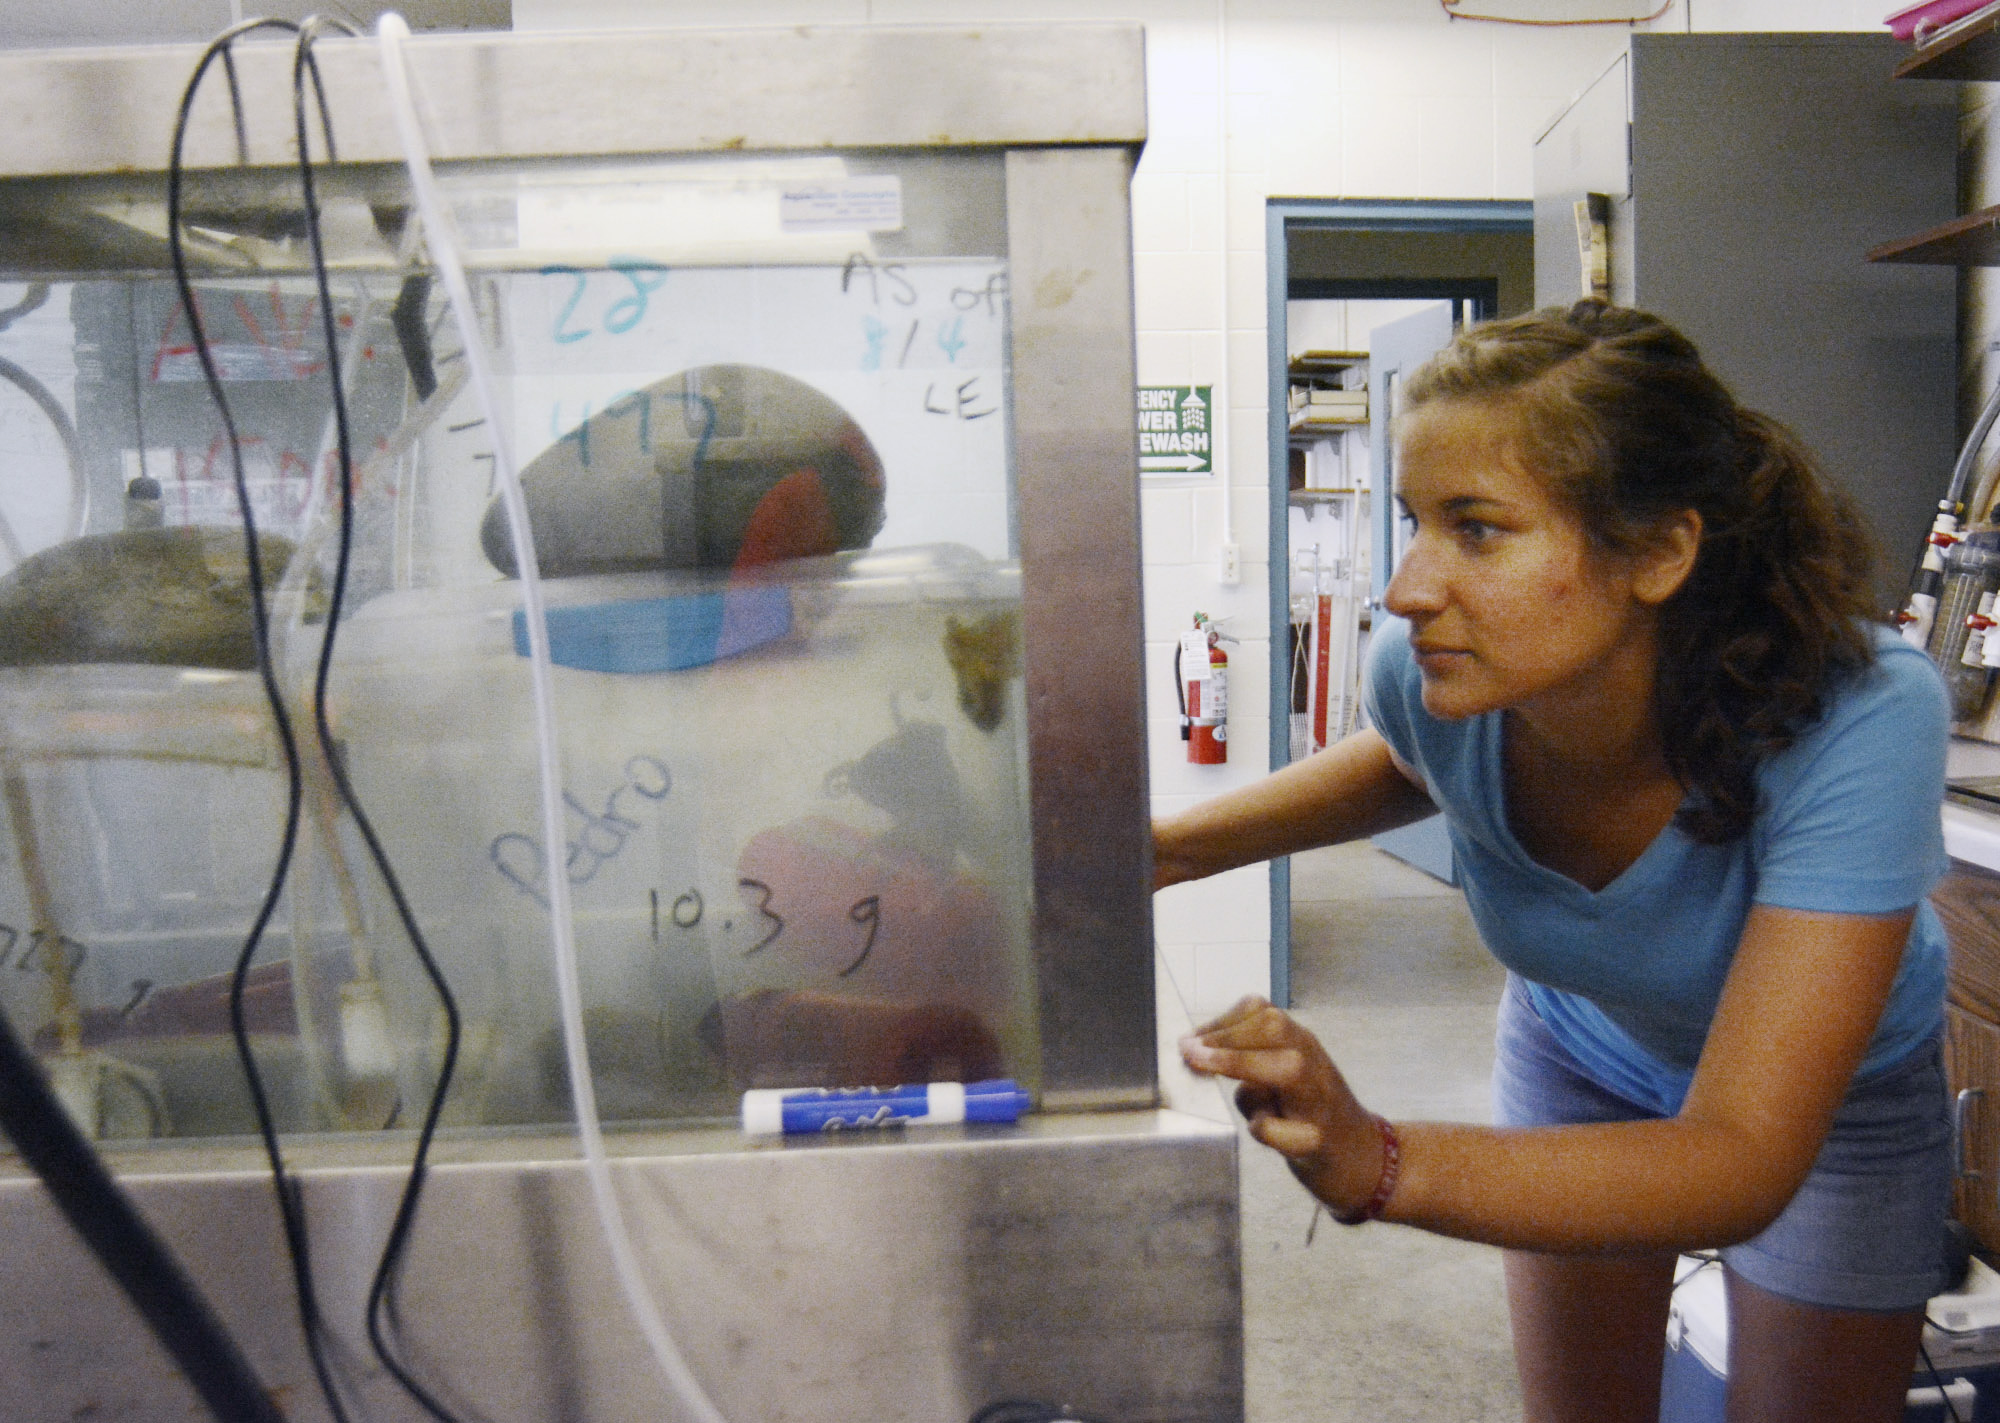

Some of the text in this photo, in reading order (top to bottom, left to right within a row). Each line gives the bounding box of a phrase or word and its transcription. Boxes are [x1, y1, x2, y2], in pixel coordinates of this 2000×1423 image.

[539, 254, 670, 345] 28
[923, 376, 999, 421] LE
[1138, 390, 1177, 409] ENCY
[490, 755, 672, 912] Pedro
